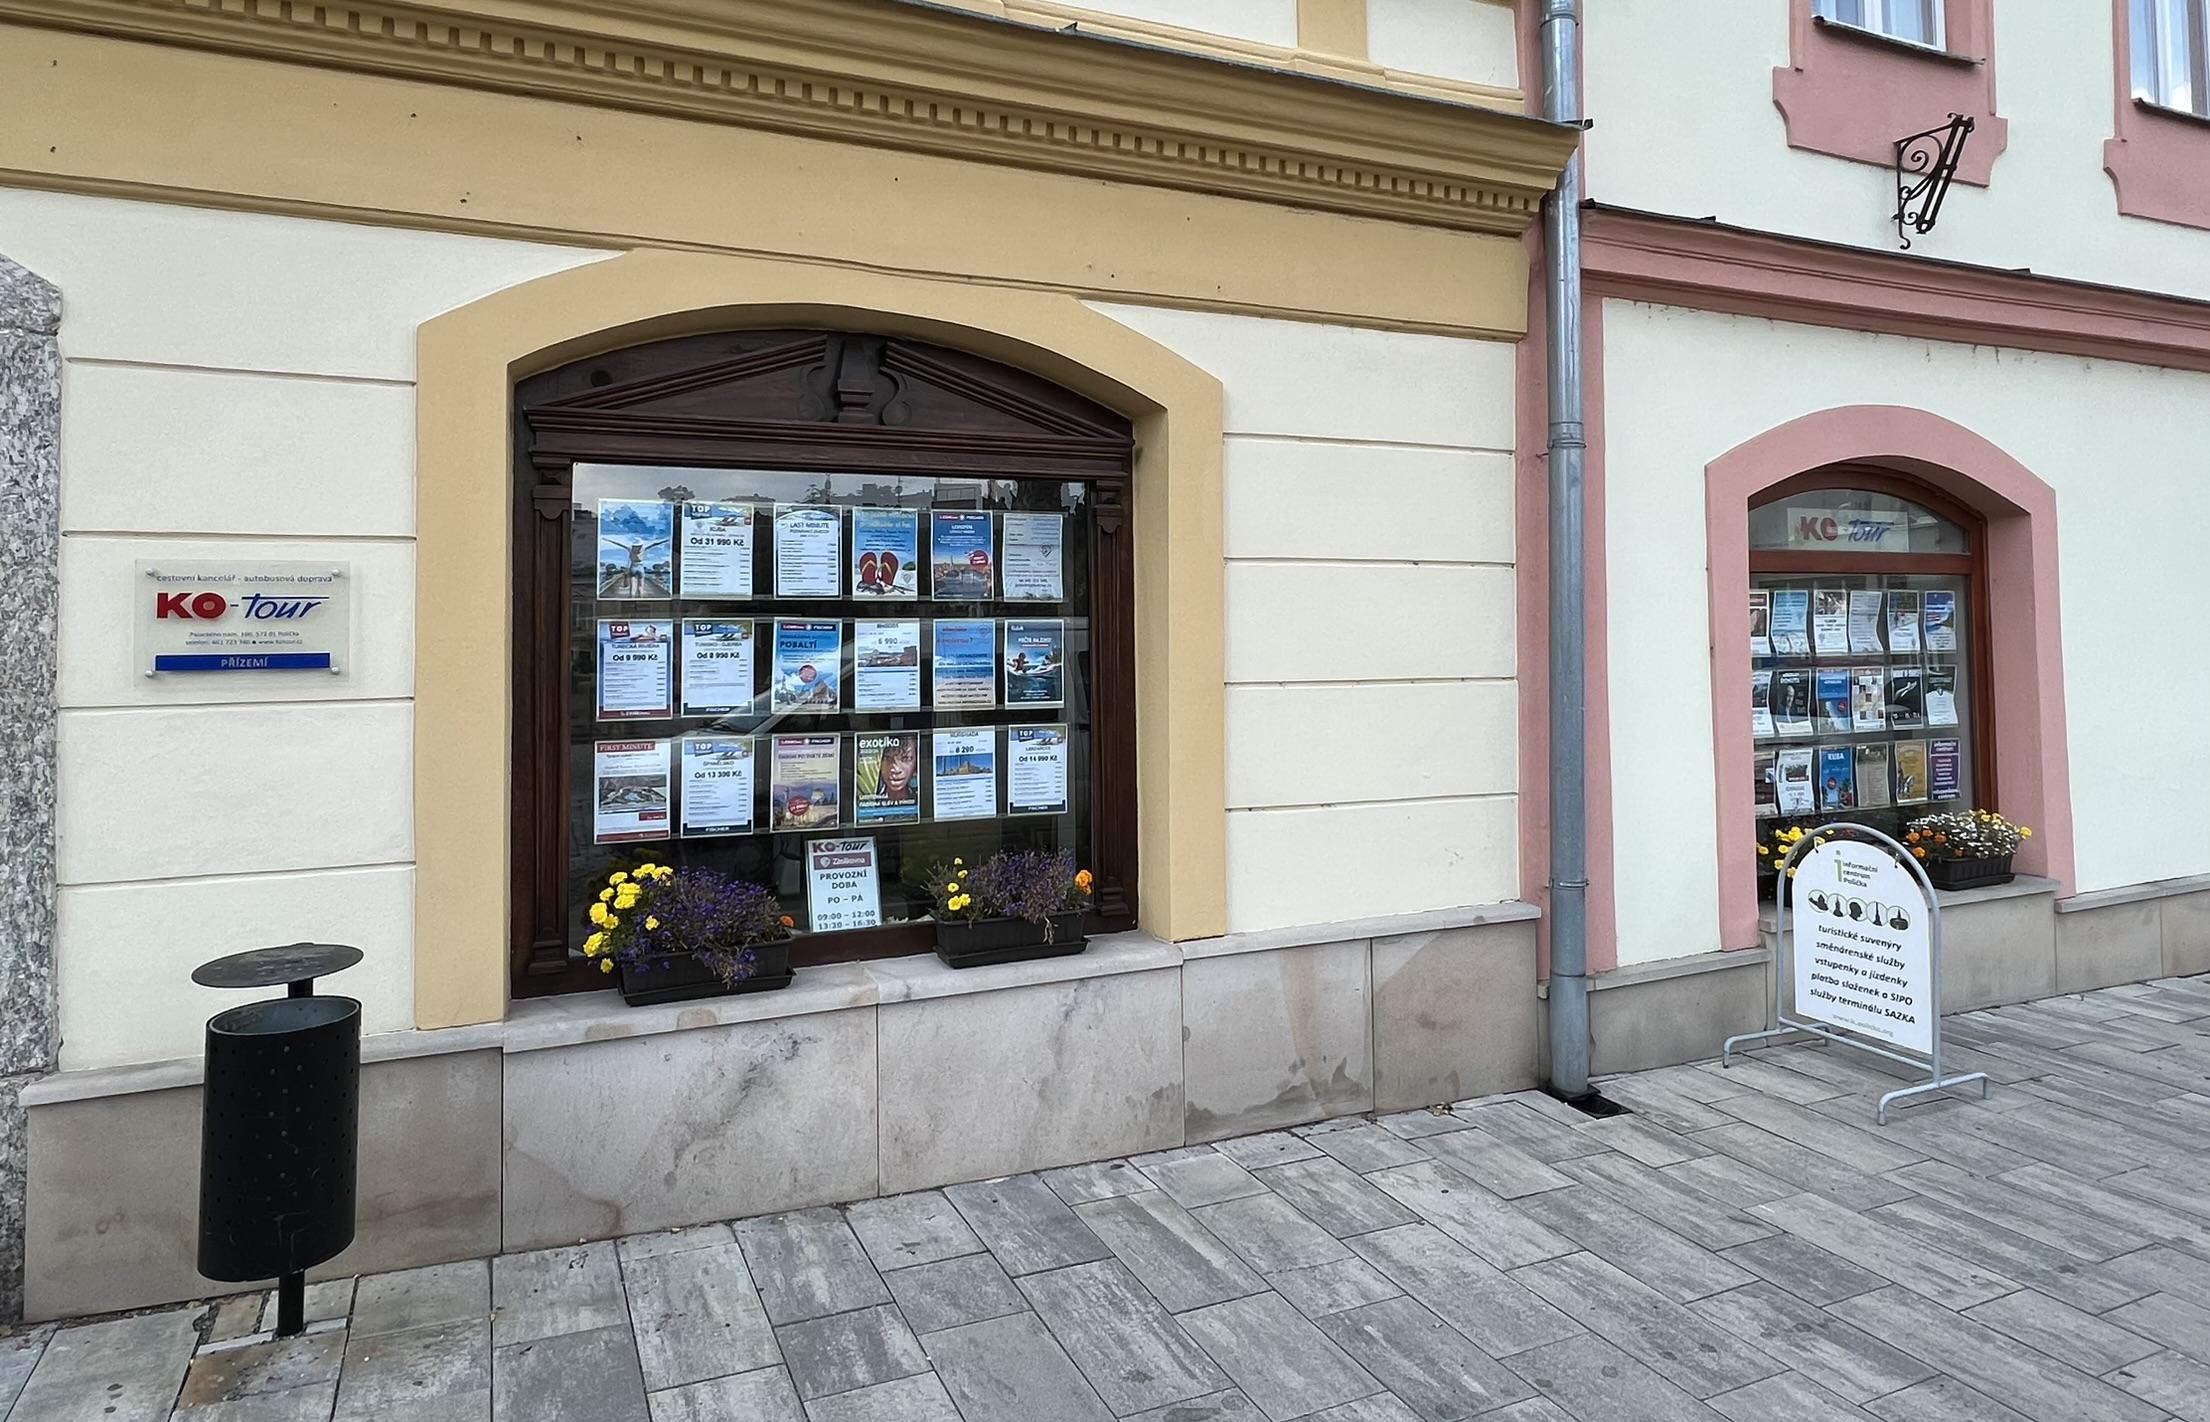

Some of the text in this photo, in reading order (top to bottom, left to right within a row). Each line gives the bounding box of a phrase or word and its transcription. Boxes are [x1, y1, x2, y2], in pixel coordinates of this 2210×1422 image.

[692, 505, 711, 513] TOP
[690, 537, 703, 545] Od
[733, 538, 744, 547] Kč
[156, 574, 195, 582] cestovní
[197, 574, 236, 582] kancelář
[243, 574, 295, 583] autobusová
[297, 574, 333, 584] doprava
[780, 639, 817, 649] POBALTÍ
[884, 637, 898, 645] 990
[730, 651, 740, 659] Kč
[220, 656, 269, 669] PŘÍZEMÍ
[599, 742, 655, 752] FIRST MINUTE
[859, 736, 900, 748] exotika
[1050, 754, 1058, 762] Kč
[694, 771, 706, 779] Od
[1842, 861, 1878, 873] informační
[819, 869, 868, 881] PROVOZNÍ
[1842, 869, 1871, 880] centrum
[831, 881, 858, 890] DOBA
[827, 896, 840, 904] PO
[817, 912, 842, 921] 09:00
[852, 910, 876, 918] 12:00
[1818, 924, 1902, 952] turistické suvenýry
[1816, 941, 1905, 971] směnárenské služby
[1814, 957, 1908, 988] vstupenky a jízdenky
[1811, 973, 1840, 986] platba
[1841, 981, 1880, 998] složenek
[1890, 993, 1914, 1006] SIPO
[1810, 988, 1916, 1025] služby terminálu SAZKA
